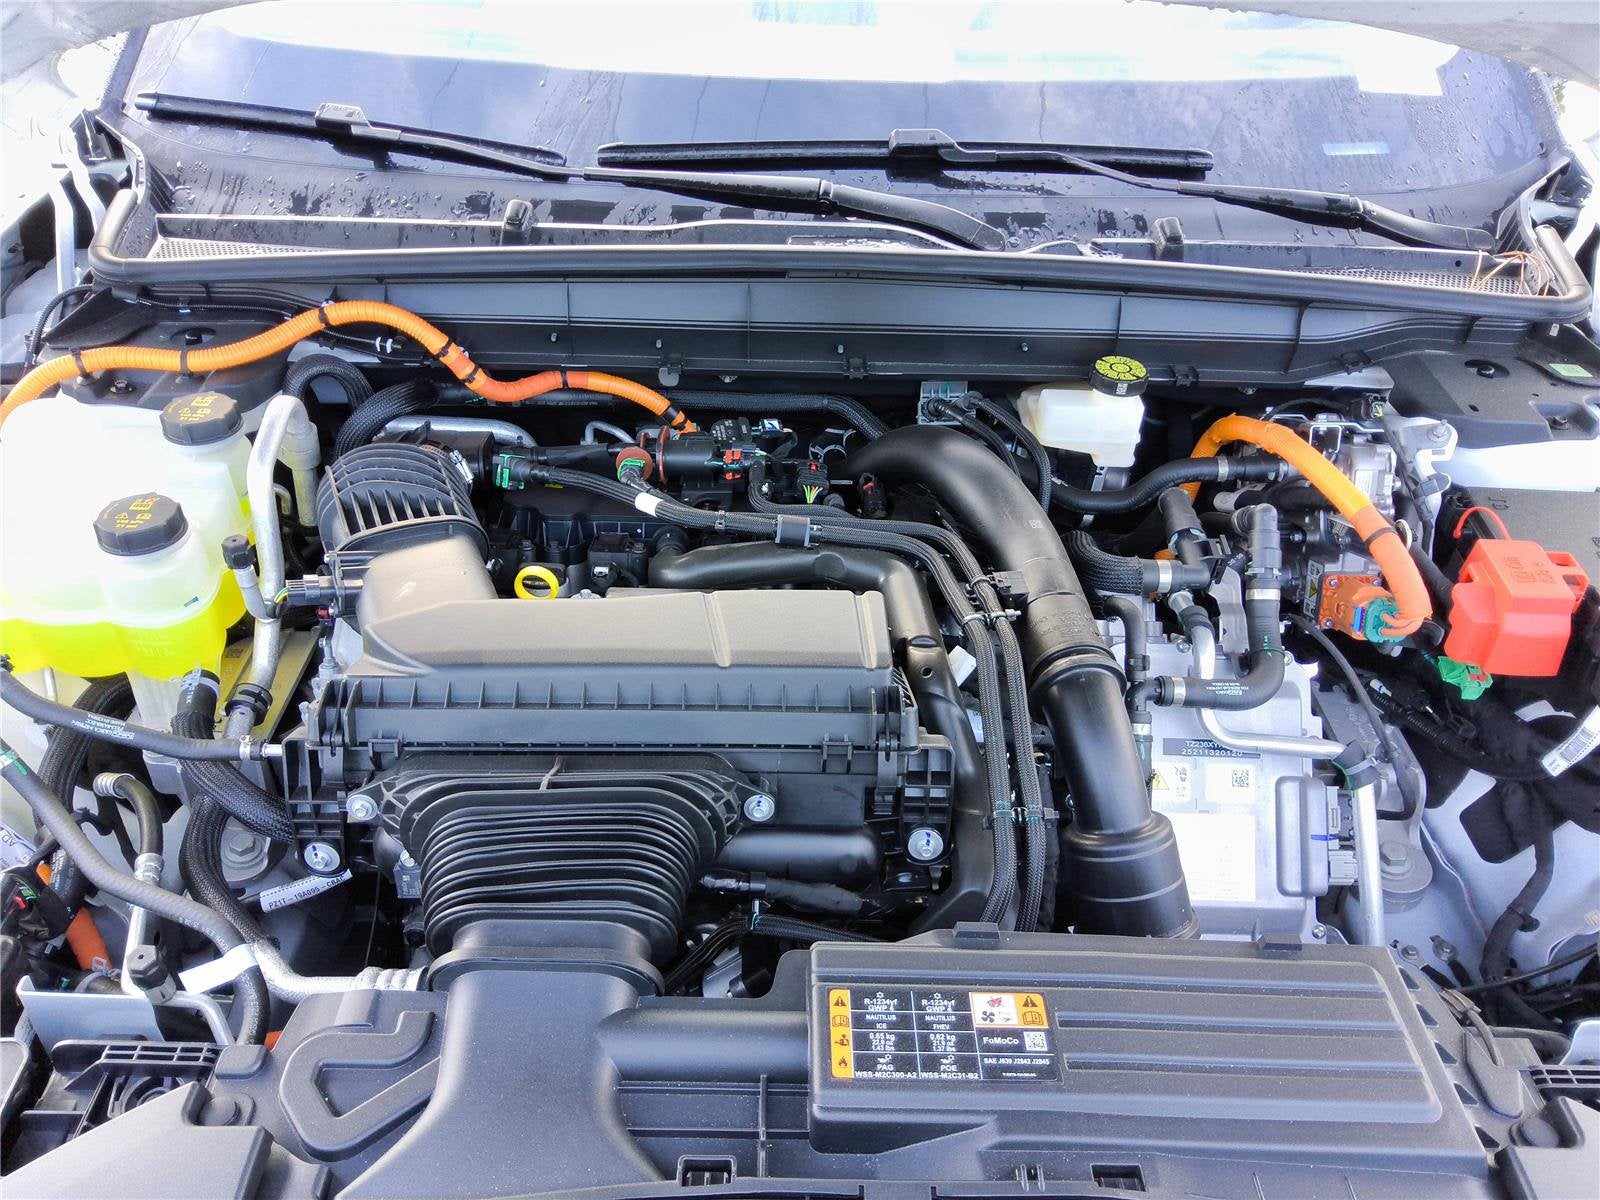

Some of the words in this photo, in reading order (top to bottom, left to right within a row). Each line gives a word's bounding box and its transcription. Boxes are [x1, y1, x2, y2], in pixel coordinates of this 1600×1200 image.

[864, 998, 898, 1006] R-1234yf
[922, 999, 955, 1007] R-1234yf
[982, 1036, 1019, 1044] FoMoCo
